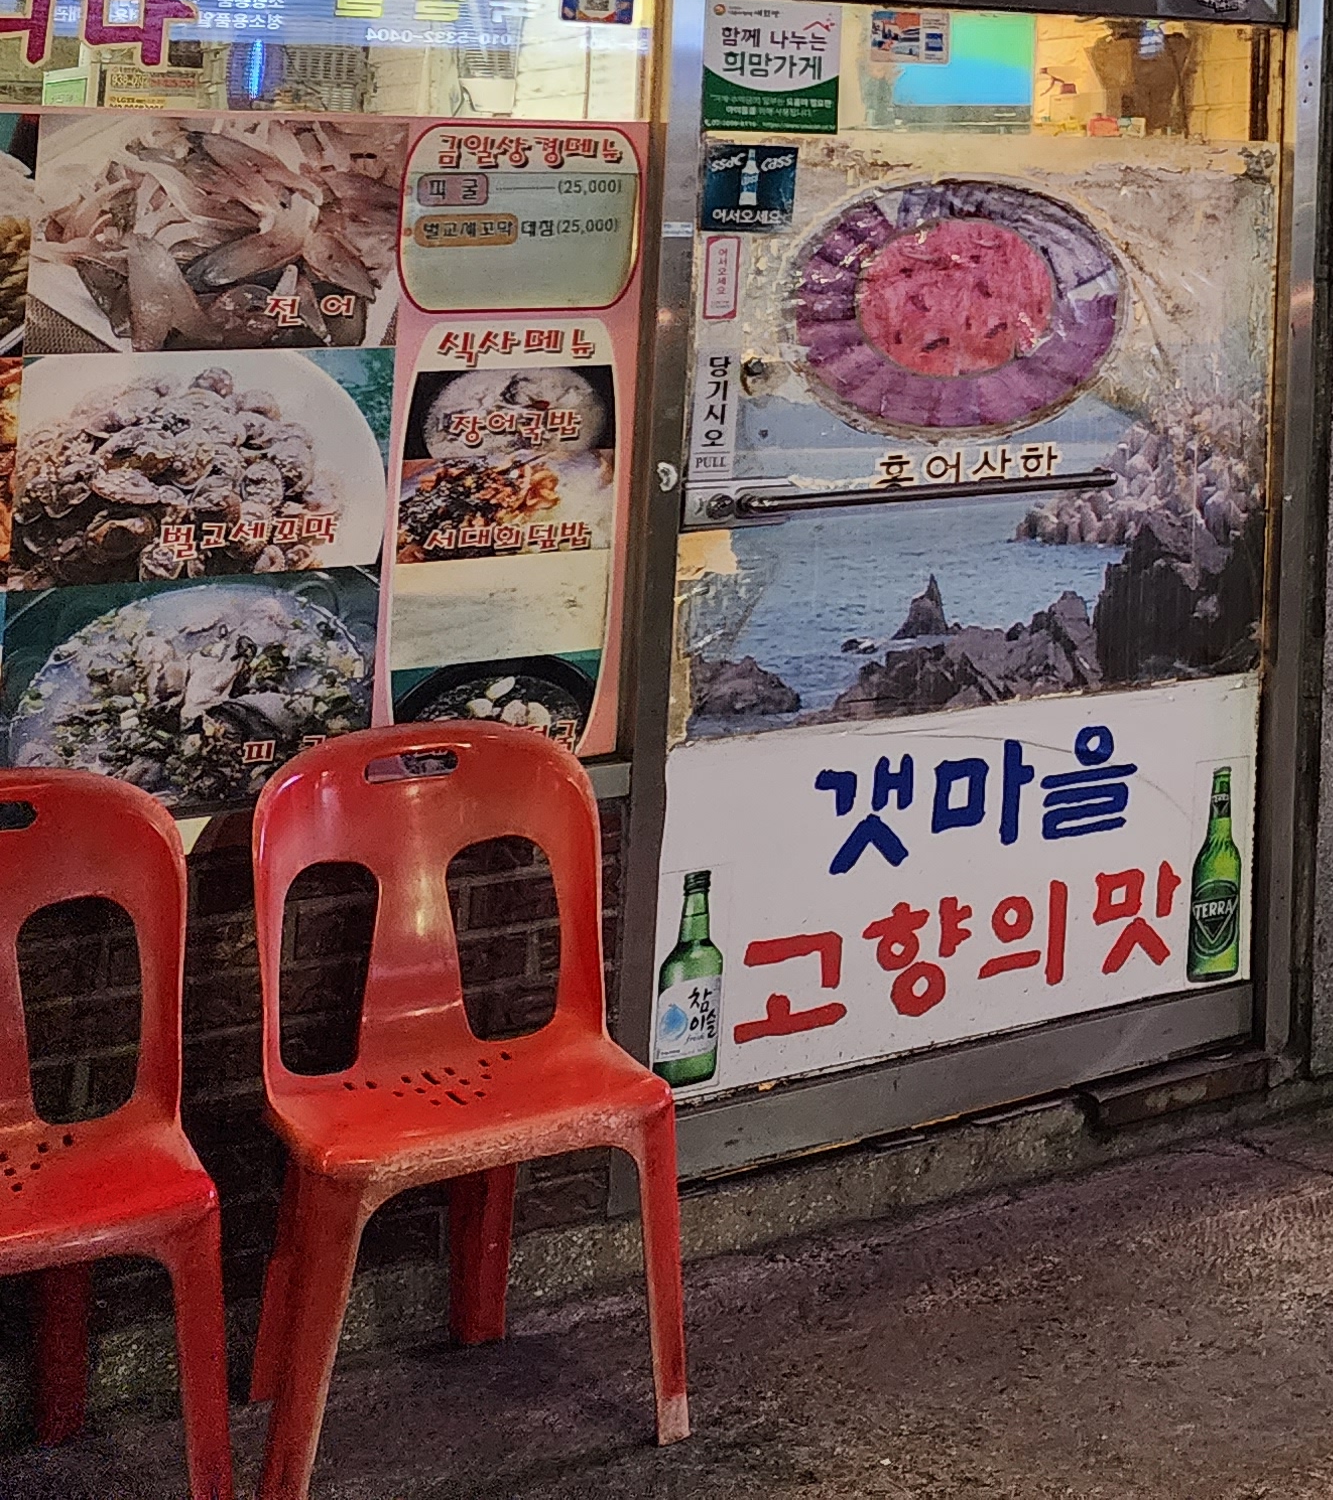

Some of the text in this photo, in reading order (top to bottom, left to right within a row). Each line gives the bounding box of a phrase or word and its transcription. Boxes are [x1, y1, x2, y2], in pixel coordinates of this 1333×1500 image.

[721, 26, 828, 52] 함께 나누는
[722, 50, 822, 81] 희망가게
[712, 208, 782, 225] 어서오세요
[436, 328, 595, 367] 식사메뉴
[702, 354, 728, 449] 당기시오
[451, 409, 581, 446] 장어국밥
[695, 455, 728, 469] PULL
[814, 724, 1138, 875] 갯마을
[1194, 899, 1234, 921] TERRA
[733, 860, 1181, 1045] 고향의맛
